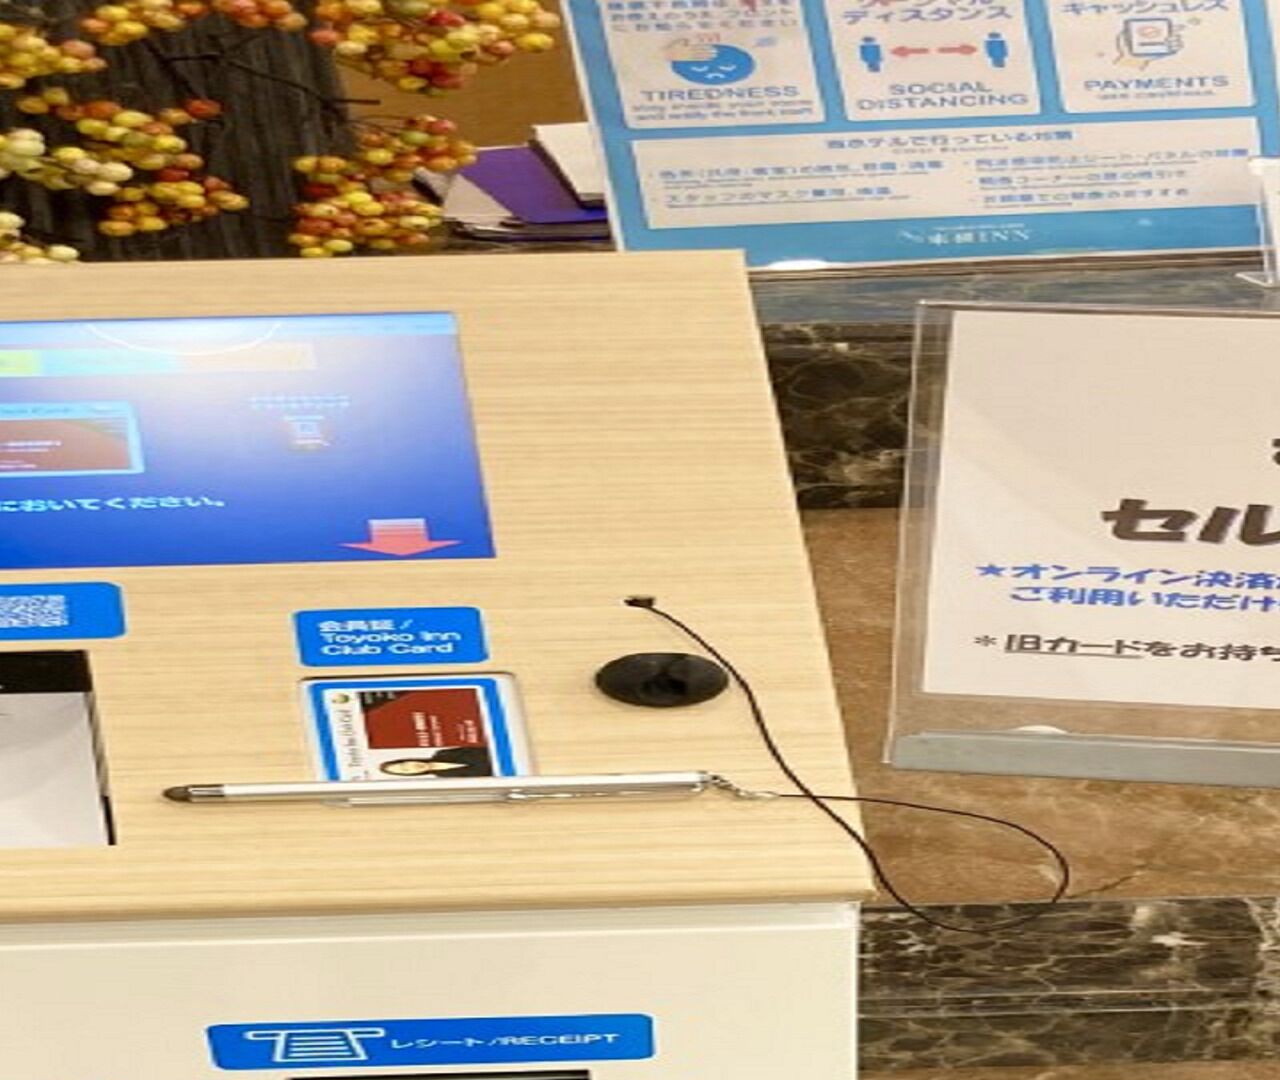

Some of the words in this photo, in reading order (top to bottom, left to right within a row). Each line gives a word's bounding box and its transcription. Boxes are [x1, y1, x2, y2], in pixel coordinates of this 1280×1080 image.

[843, 6, 1013, 25] ディスタンス
[888, 81, 994, 96] SOCIAL
[1083, 75, 1229, 91] PAYMENTS
[640, 86, 800, 102] TIREDNESS
[857, 94, 1028, 111] DISTANCING
[320, 633, 414, 645] Toyoko
[419, 631, 461, 642] Inn
[321, 644, 382, 656] Club
[388, 642, 454, 654] Card
